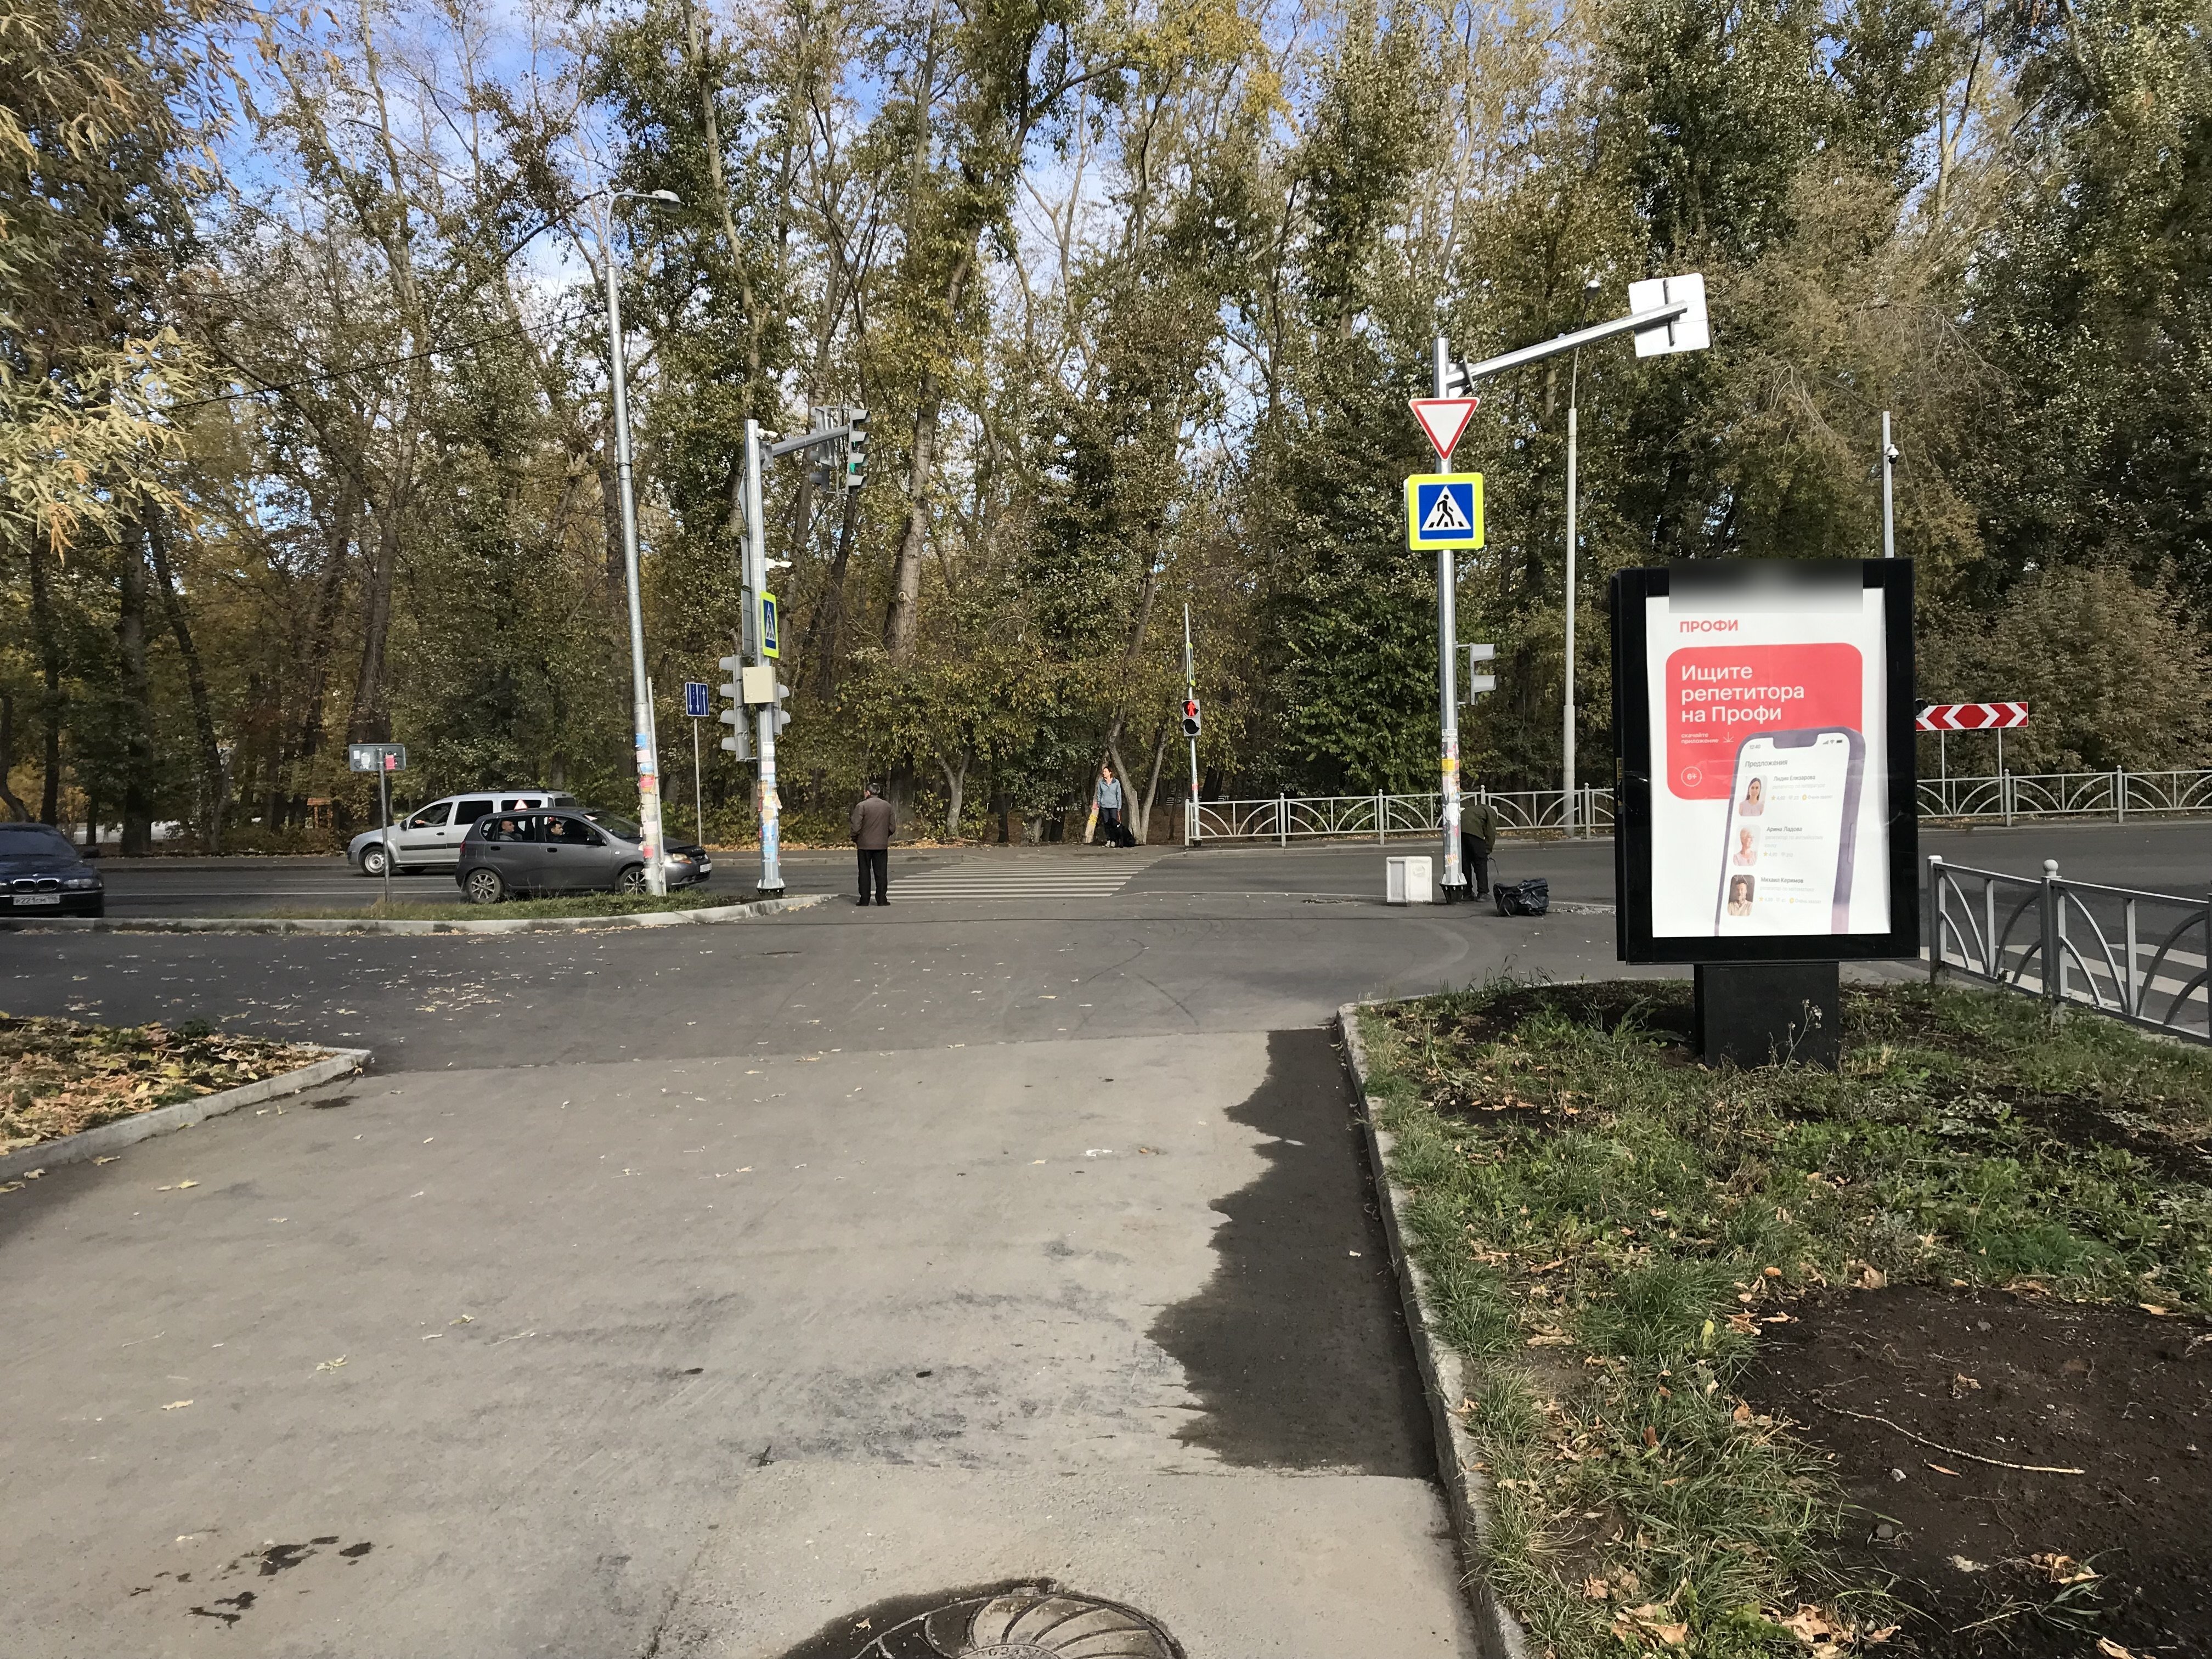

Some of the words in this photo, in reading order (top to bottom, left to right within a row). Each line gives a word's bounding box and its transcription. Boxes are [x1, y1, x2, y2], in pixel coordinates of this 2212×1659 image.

[1680, 619, 1738, 633] ПРОФИ
[1681, 665, 1753, 682] Ищите
[1681, 686, 1804, 706] репетитора
[1681, 709, 1706, 723] на
[1712, 705, 1781, 725] Профи
[1745, 760, 1788, 768] Предложения
